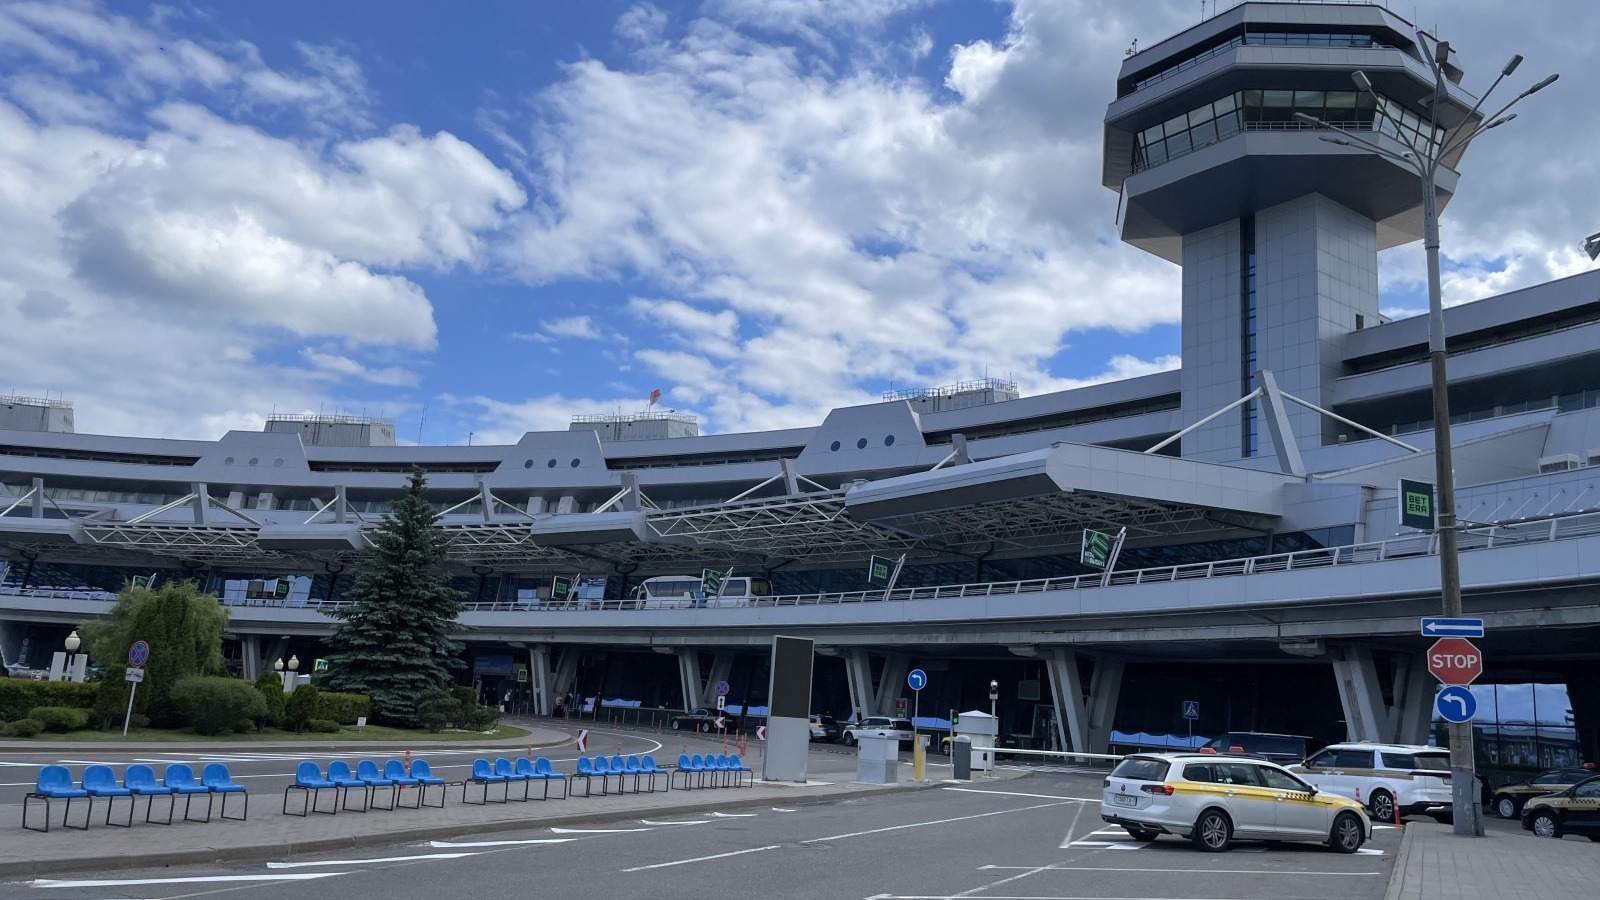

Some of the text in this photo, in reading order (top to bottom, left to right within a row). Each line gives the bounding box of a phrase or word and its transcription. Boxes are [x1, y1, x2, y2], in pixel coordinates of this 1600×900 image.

[1409, 495, 1427, 505] BET
[1408, 504, 1427, 513] ERA
[1432, 654, 1478, 669] STOP
